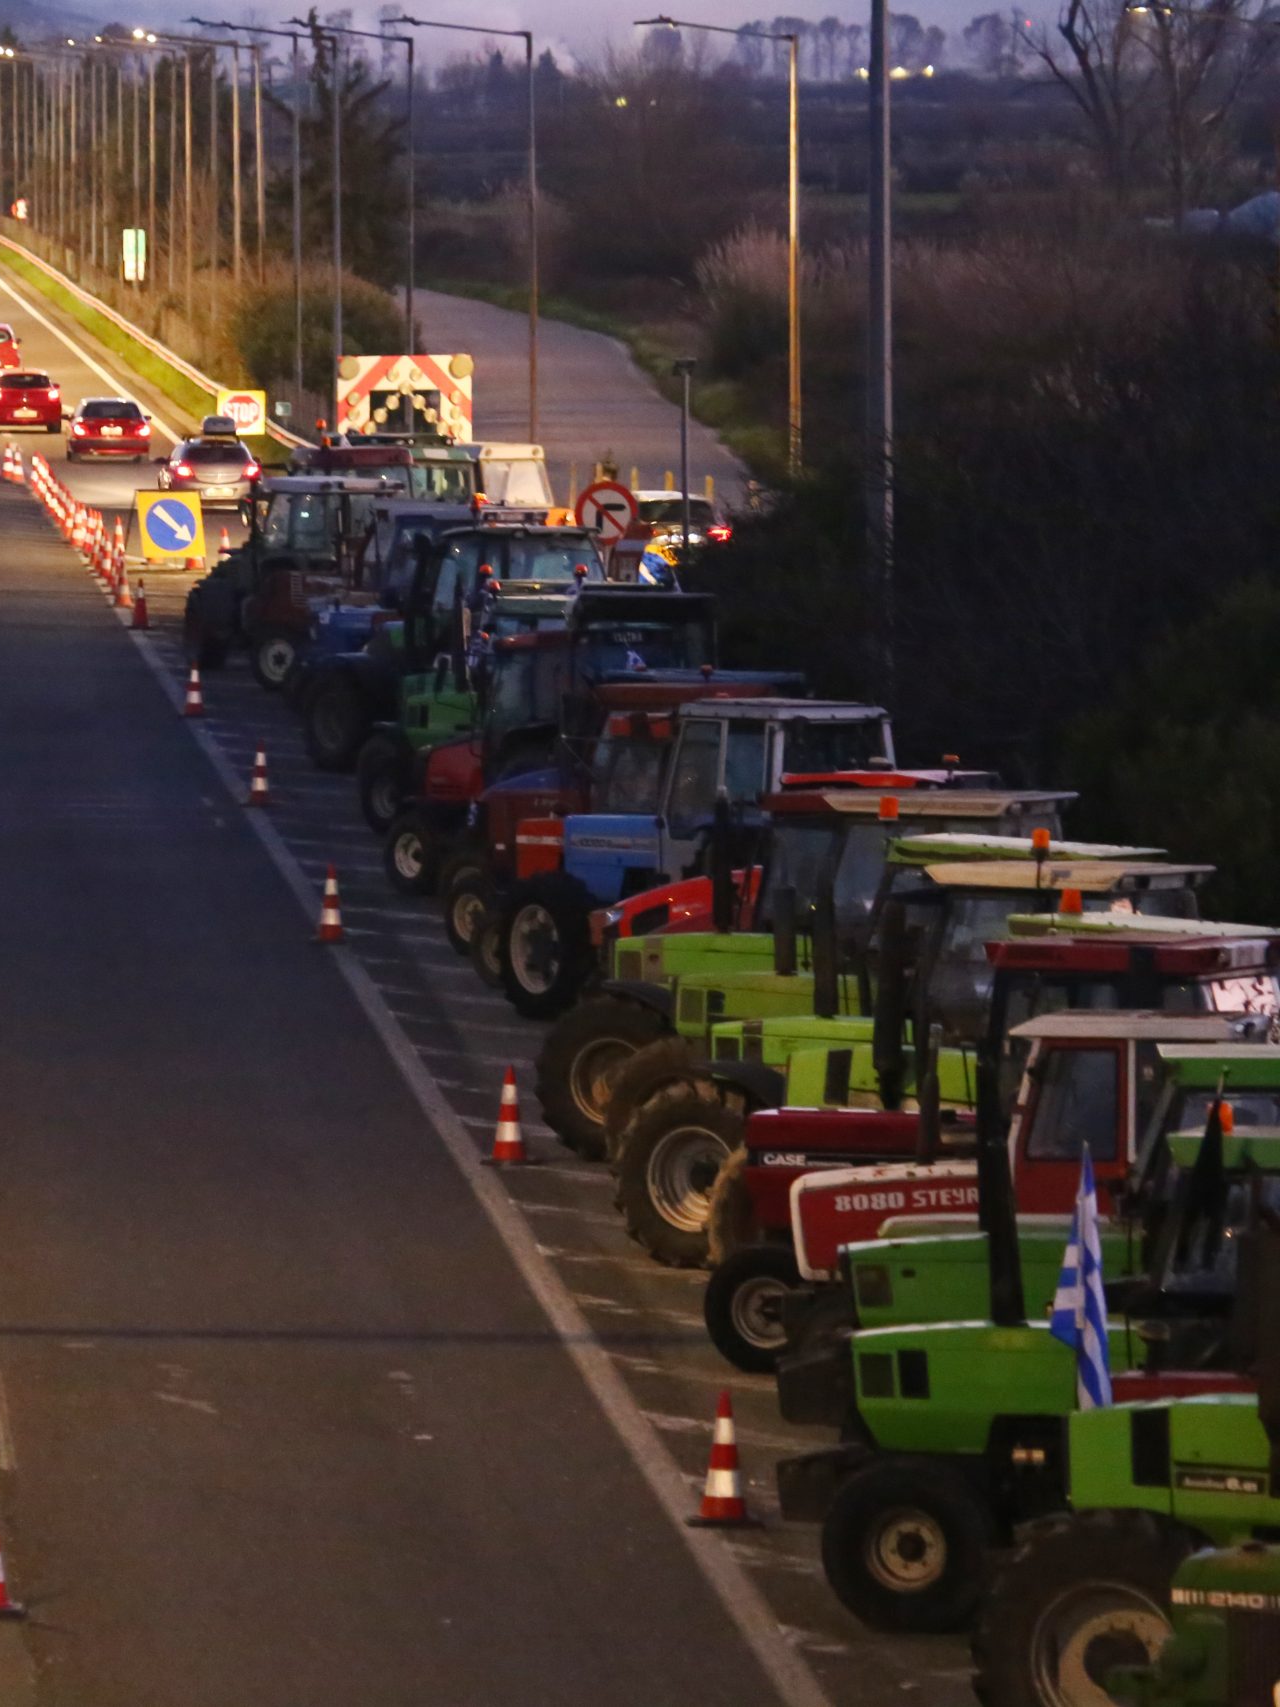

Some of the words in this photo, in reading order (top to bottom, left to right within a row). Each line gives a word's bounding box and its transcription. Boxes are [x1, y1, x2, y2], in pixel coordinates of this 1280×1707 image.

[224, 402, 258, 423] STOP
[763, 1153, 806, 1166] CASE
[835, 1192, 905, 1211] 8080
